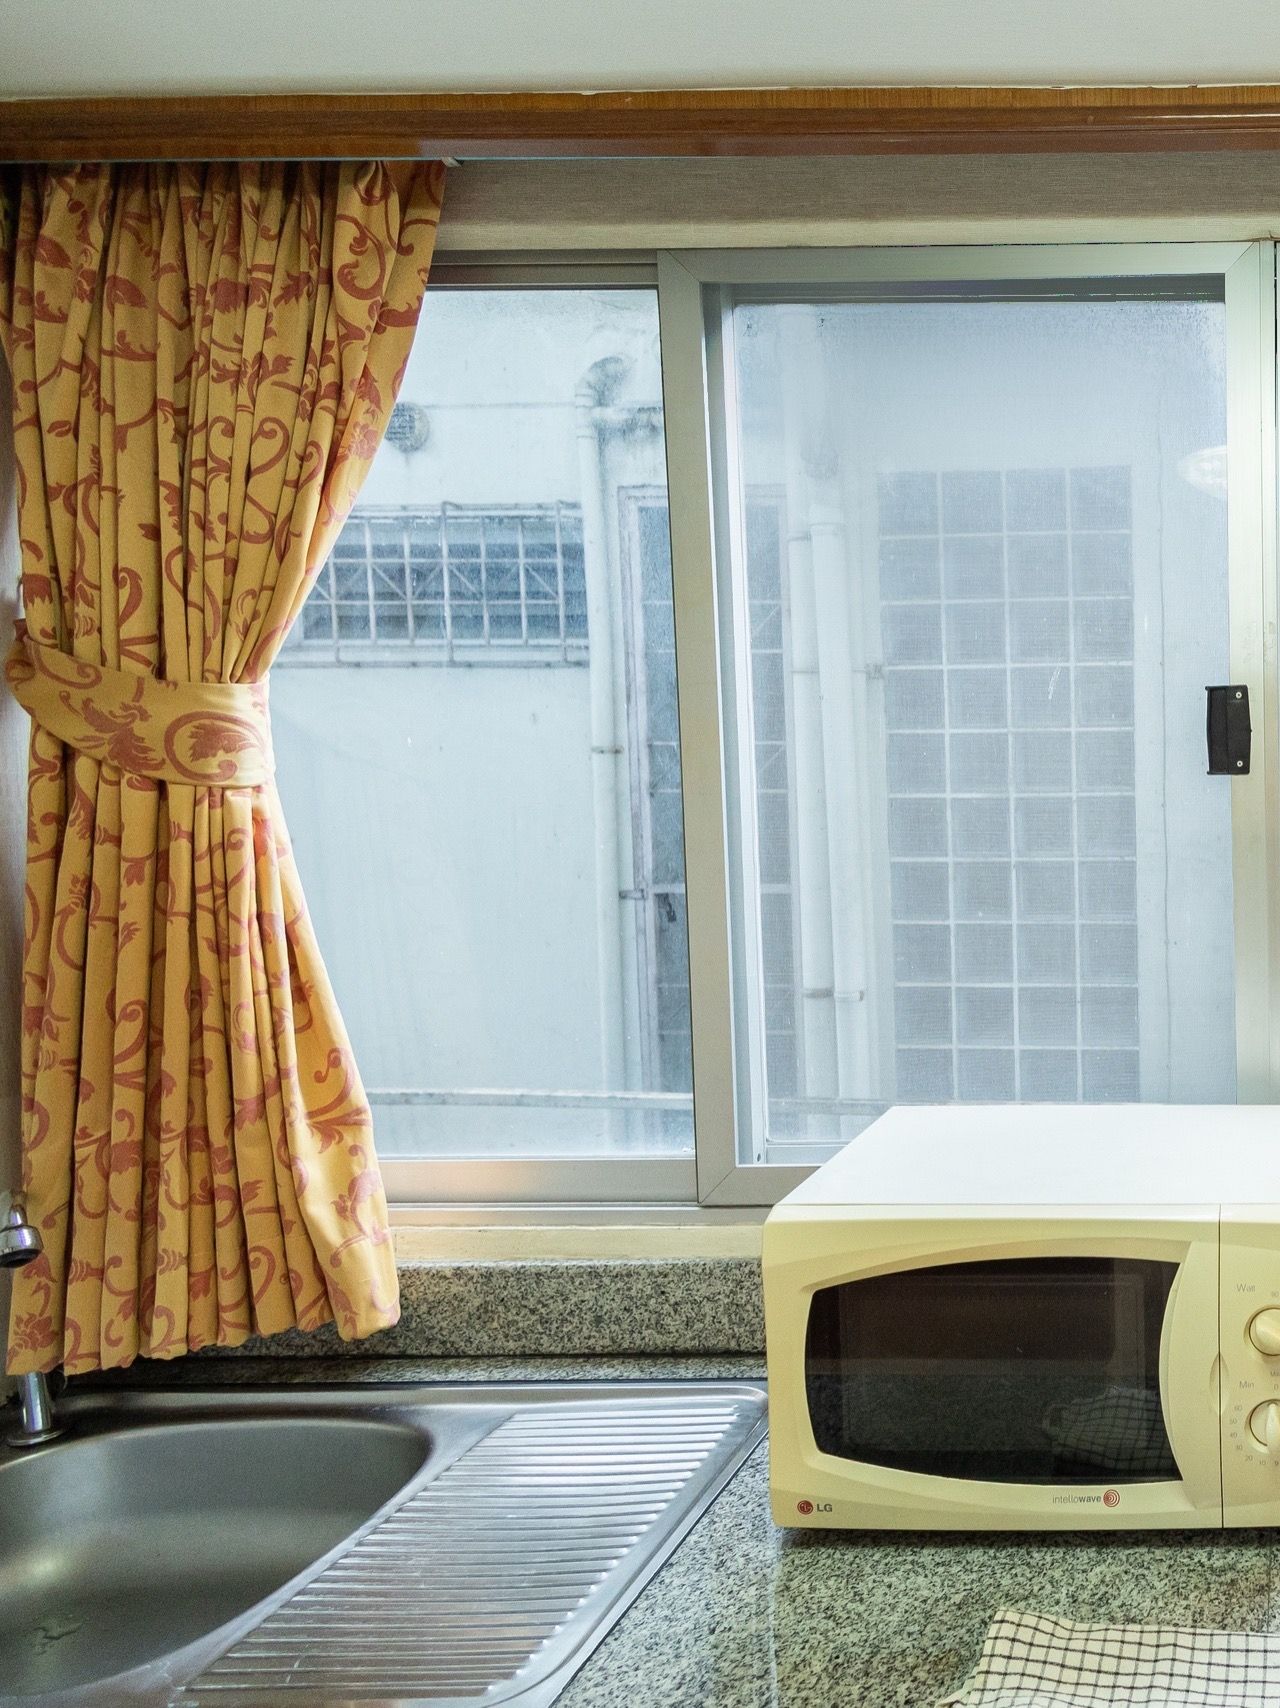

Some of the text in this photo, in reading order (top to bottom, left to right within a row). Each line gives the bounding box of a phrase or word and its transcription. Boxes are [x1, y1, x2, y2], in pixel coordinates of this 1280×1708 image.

[1236, 1283, 1256, 1293] Watt
[1239, 1380, 1255, 1389] Min
[1052, 1494, 1102, 1504] intellowave
[816, 1503, 833, 1513] LG
